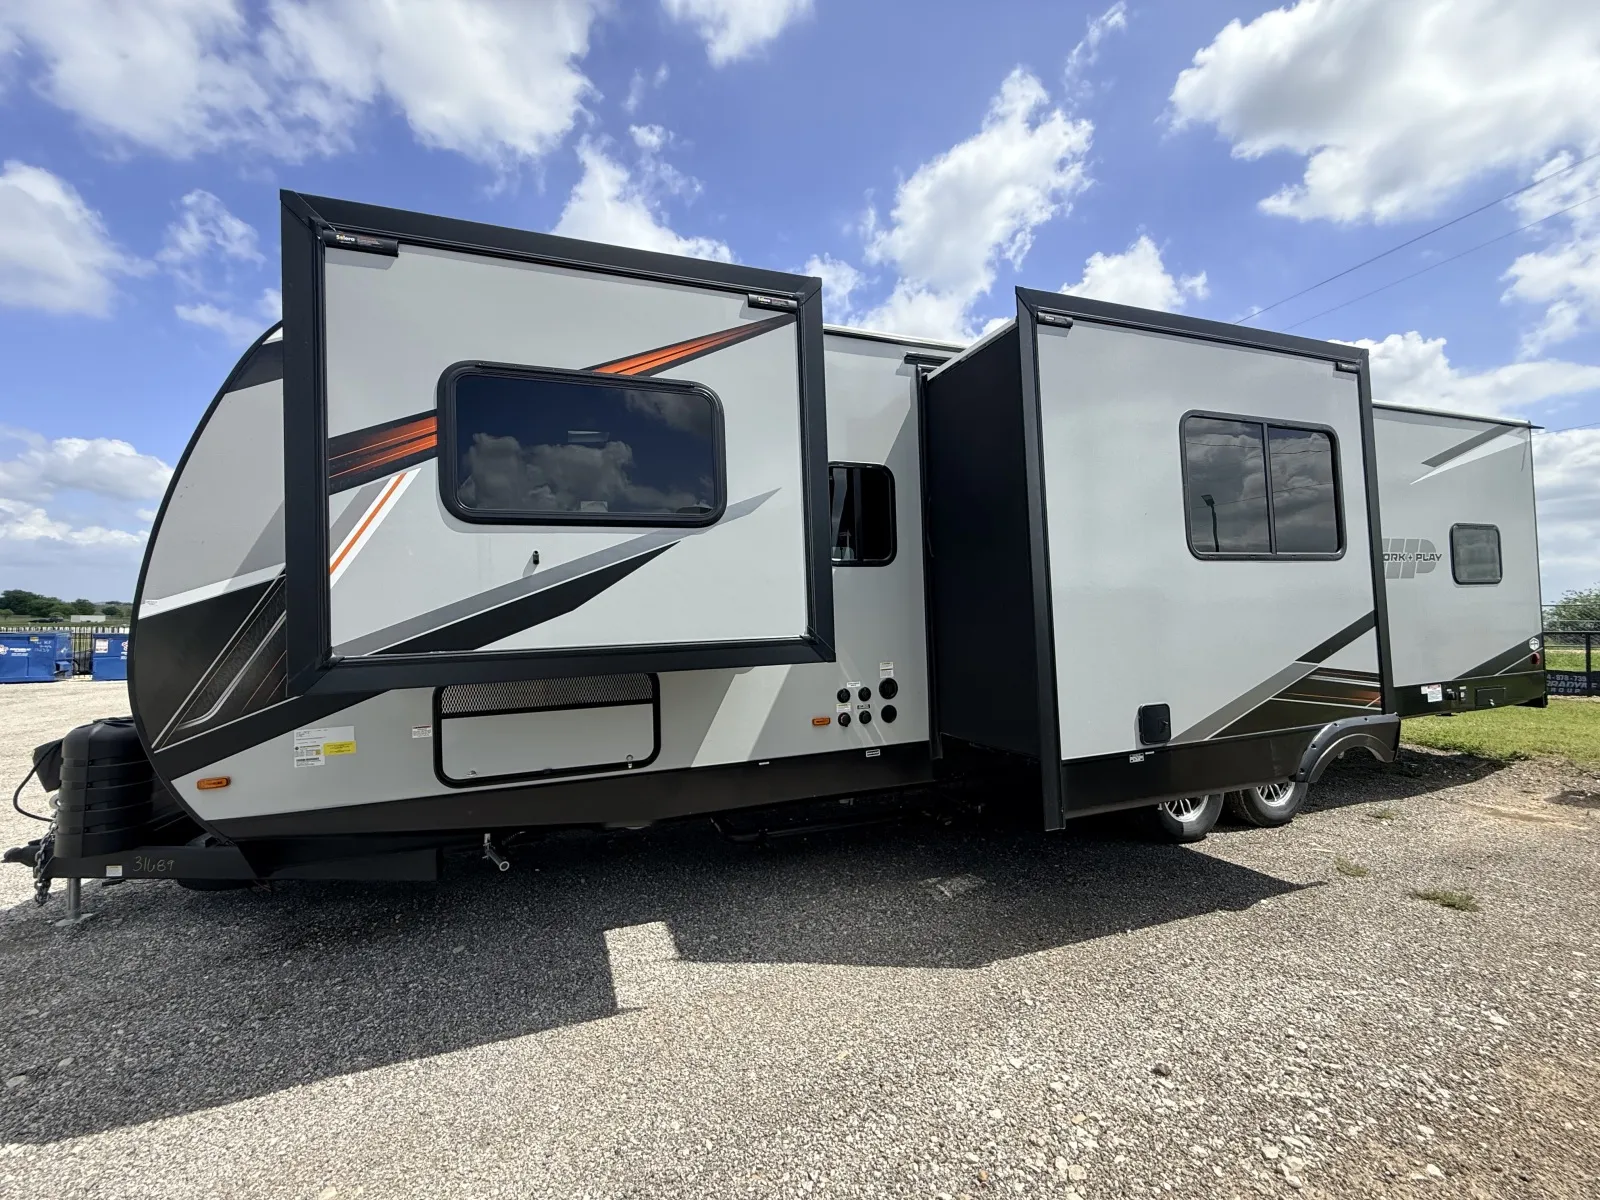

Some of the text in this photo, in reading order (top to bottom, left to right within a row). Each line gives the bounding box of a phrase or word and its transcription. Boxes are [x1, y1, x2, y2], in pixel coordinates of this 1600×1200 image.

[1382, 553, 1406, 562] ORK
[1416, 553, 1442, 562] PLAY
[131, 855, 175, 873] 31689
